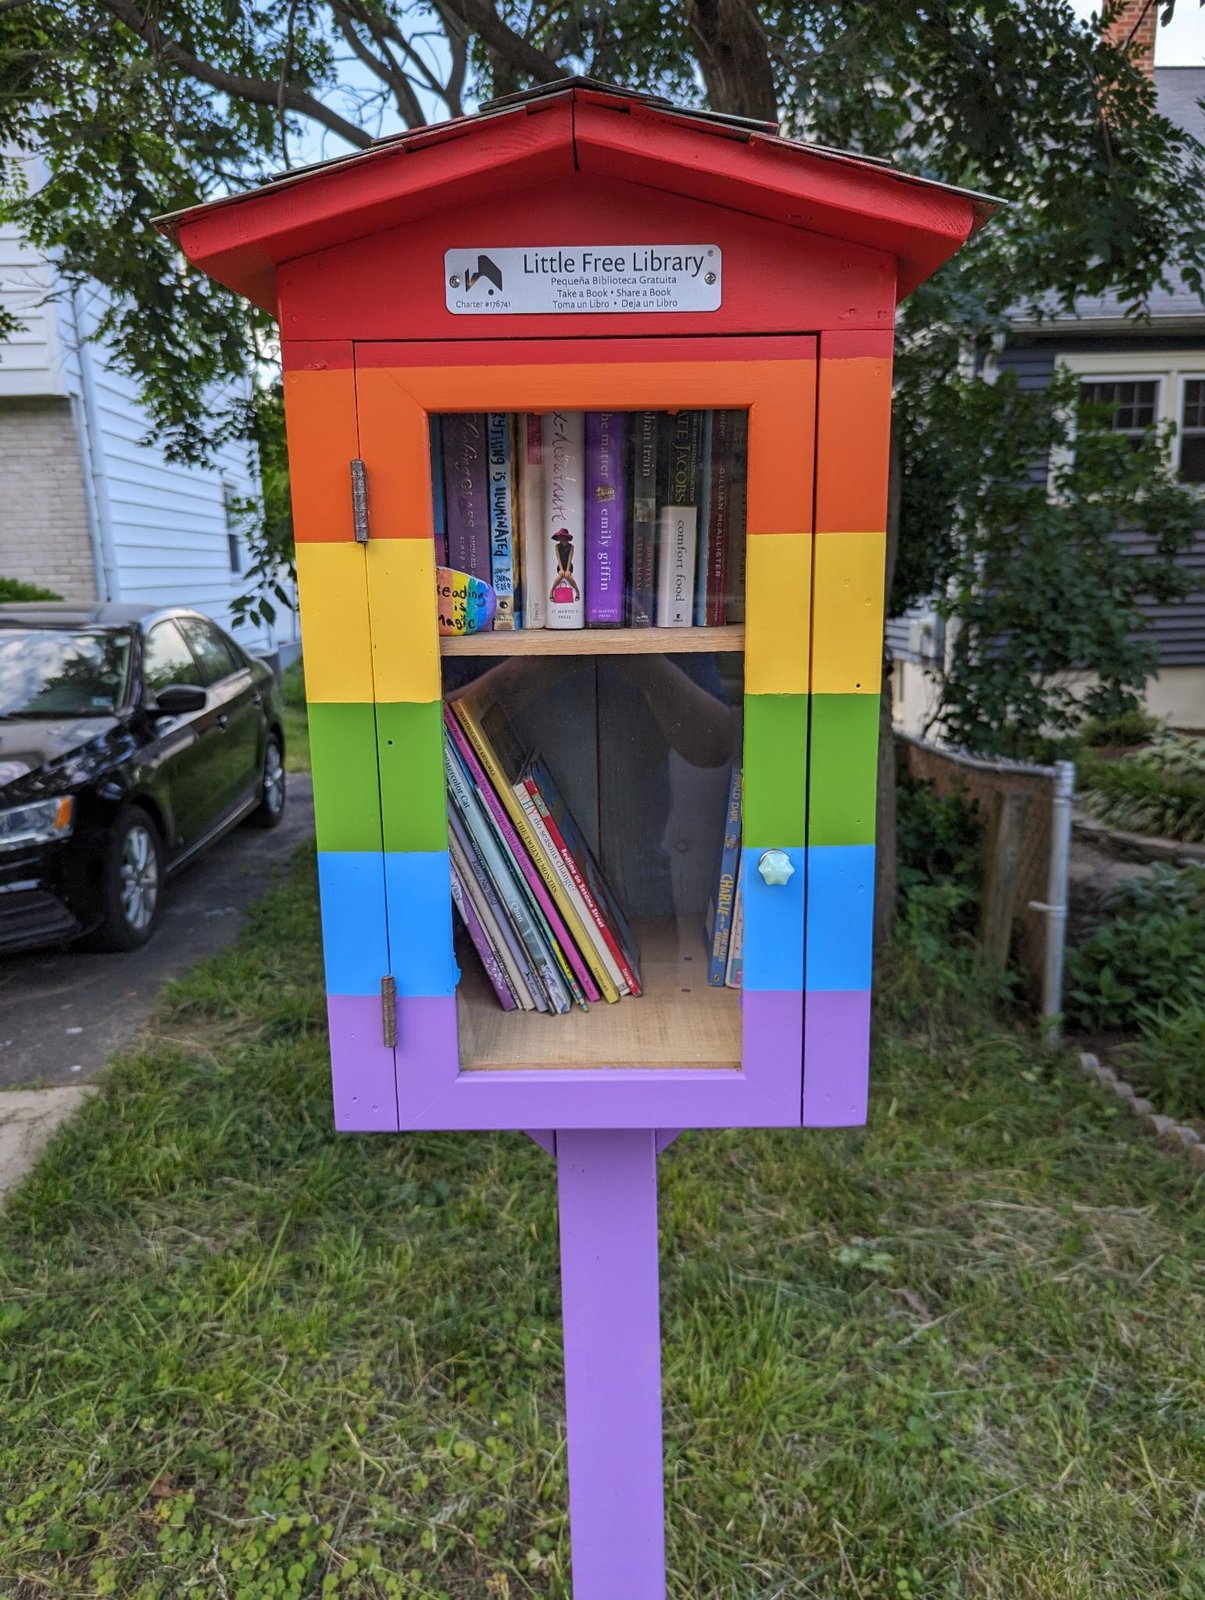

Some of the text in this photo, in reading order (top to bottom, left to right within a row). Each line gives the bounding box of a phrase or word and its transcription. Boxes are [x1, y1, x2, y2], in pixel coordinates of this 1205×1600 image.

[523, 251, 576, 274] Little
[582, 252, 626, 273] Free
[551, 275, 677, 286] Pequeña Biblioteca Gratuita
[455, 300, 483, 308] Charter
[552, 300, 575, 309] Toma
[589, 299, 610, 308] Libro
[621, 299, 641, 309] Deja
[656, 298, 678, 307] Libro
[557, 289, 577, 298] Take
[586, 288, 608, 297] Book
[616, 288, 641, 297] Share
[649, 287, 672, 296] Book
[600, 434, 609, 479] matter
[642, 444, 655, 477] train
[672, 443, 691, 503] JACOBS
[714, 467, 726, 578] GILLIAN McALLISTER
[598, 508, 612, 592] emily giffin
[675, 520, 687, 602] comfort food
[455, 601, 467, 612] is
[445, 753, 471, 809] Watercolor Cat
[516, 791, 538, 816] WHY
[534, 817, 543, 830] do
[540, 828, 558, 860] seasons
[554, 858, 577, 892] change?
[517, 821, 527, 835] THE
[523, 834, 543, 865] TWELVE
[541, 863, 558, 894] MONTHS
[452, 881, 462, 902] Viking
[486, 890, 498, 906] World
[561, 848, 605, 929] Bedtime on Sesame Street
[717, 873, 734, 917] CHARLIE
[511, 902, 523, 923] Chun
